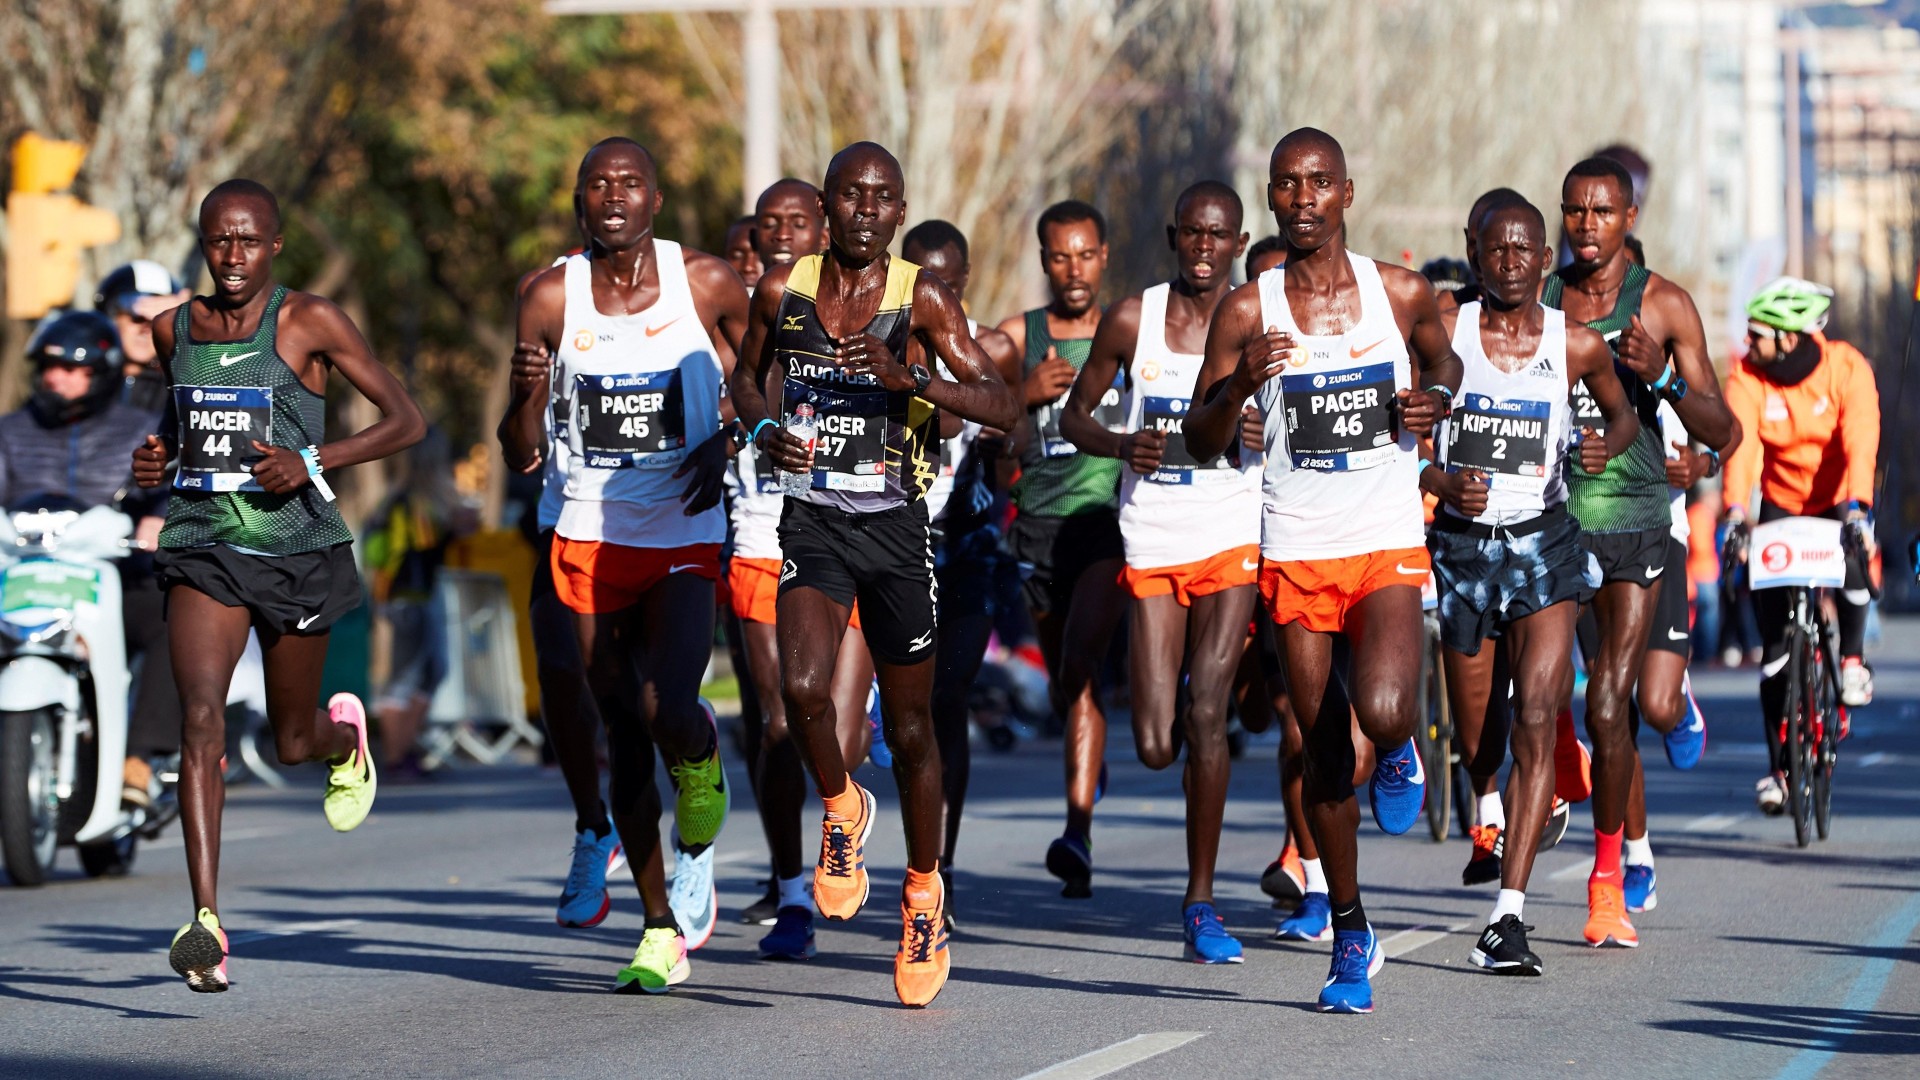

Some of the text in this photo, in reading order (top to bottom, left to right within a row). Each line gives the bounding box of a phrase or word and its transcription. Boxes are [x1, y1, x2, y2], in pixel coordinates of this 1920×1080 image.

[616, 377, 649, 387] ZURICH
[1164, 369, 1179, 377] NN
[1329, 372, 1362, 385] ZURICH
[1529, 369, 1558, 379] adidas
[204, 392, 237, 401] ZURICH
[601, 393, 665, 414] PACER
[820, 395, 852, 407] ZURICH
[1311, 388, 1378, 415] PACER
[1492, 402, 1521, 411] ZURICH
[189, 410, 251, 431] PACER
[619, 416, 650, 438] 45
[813, 413, 866, 436] ACER
[1332, 413, 1363, 437] 46
[1462, 413, 1542, 440] KIPTANUI
[202, 434, 232, 457] 44
[816, 436, 847, 457] 47
[1491, 438, 1507, 460] 2
[1310, 459, 1335, 469] asics
